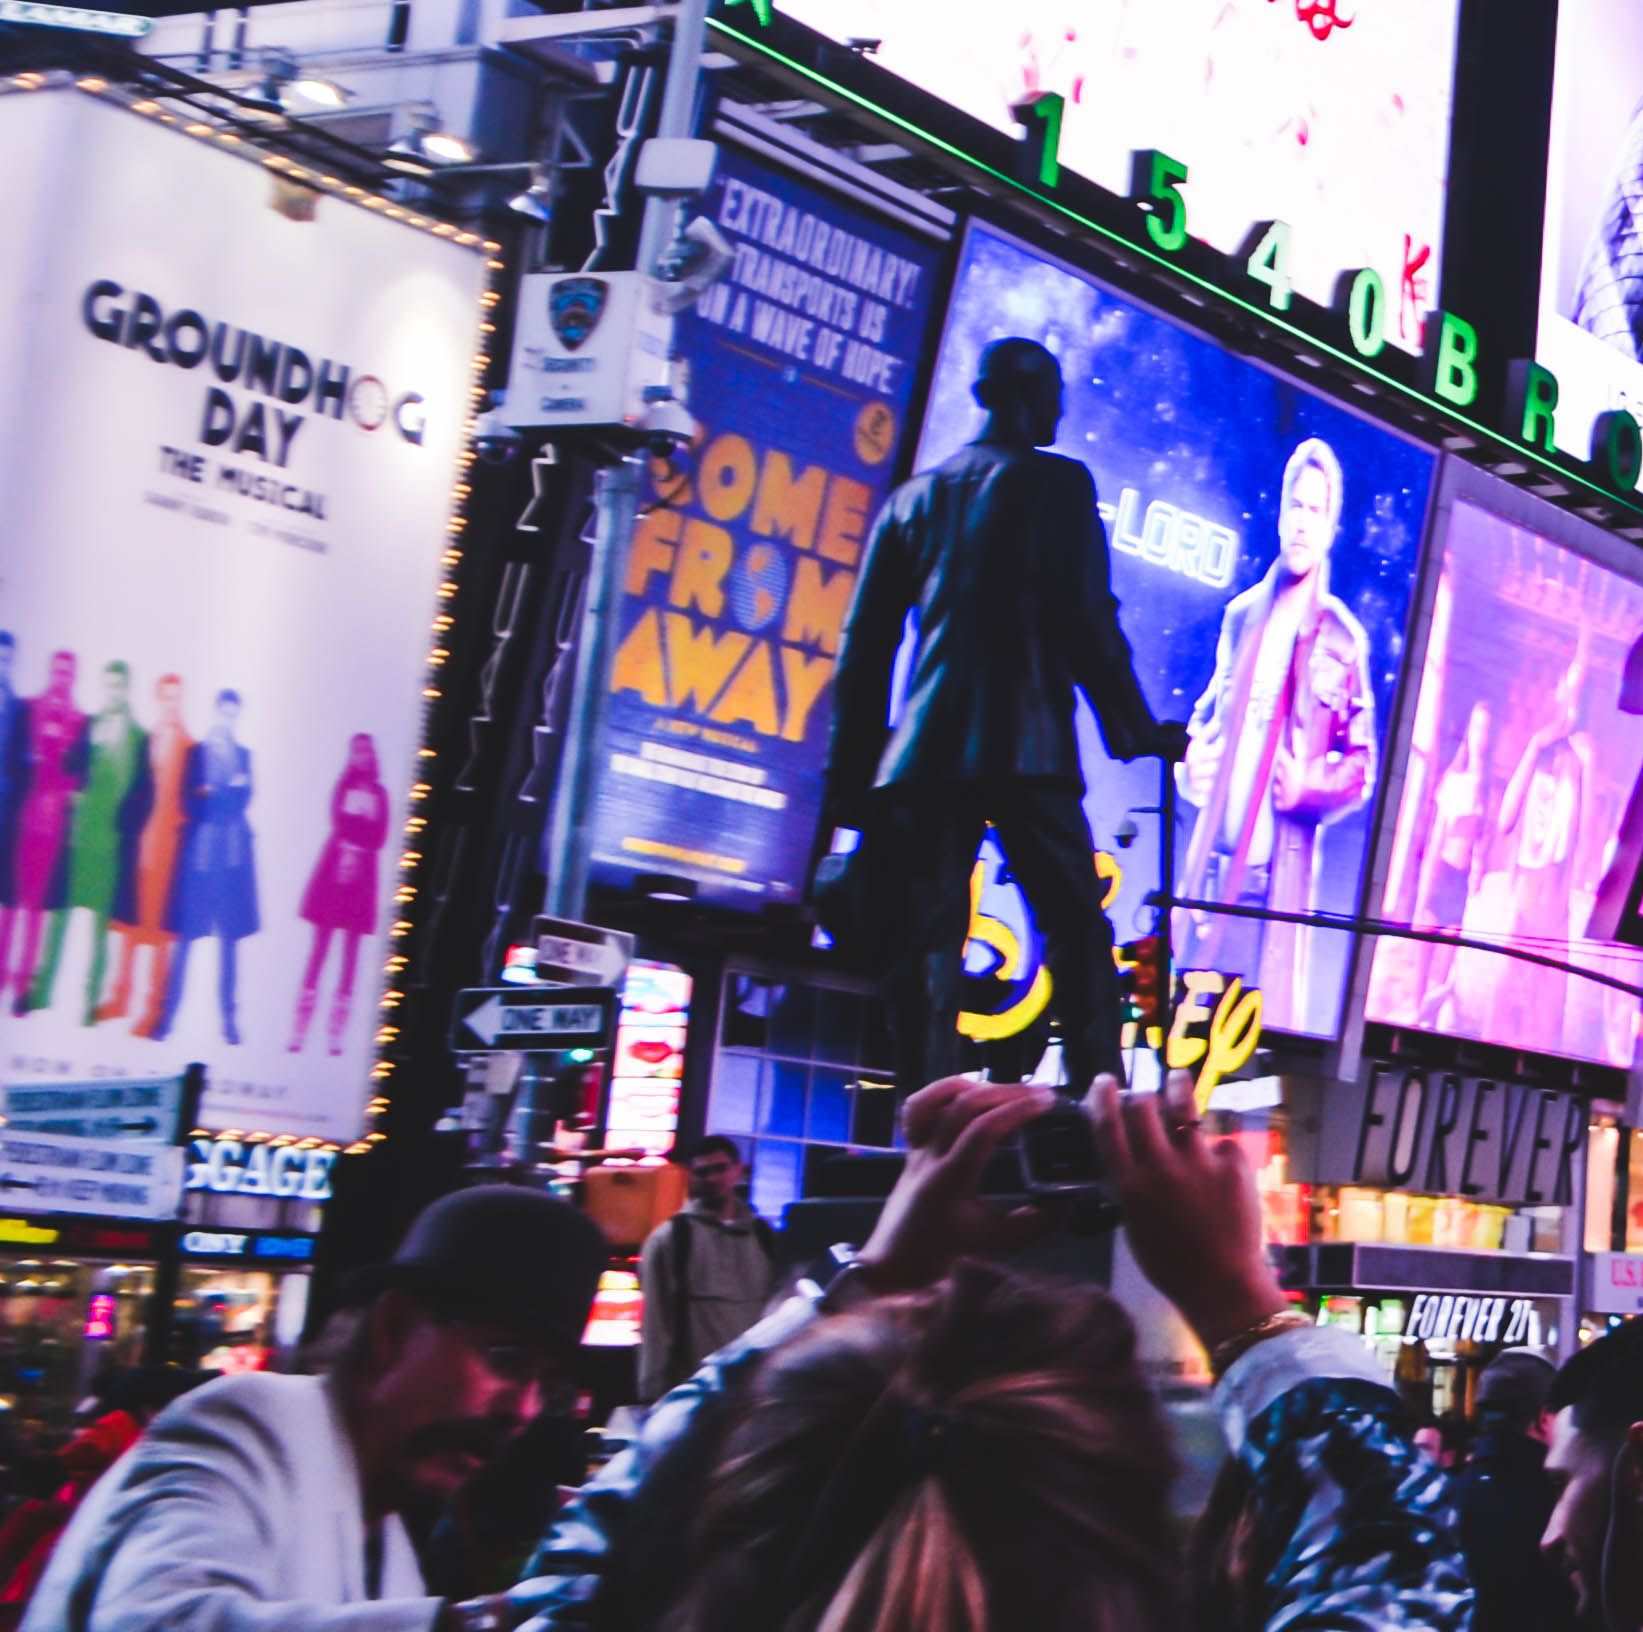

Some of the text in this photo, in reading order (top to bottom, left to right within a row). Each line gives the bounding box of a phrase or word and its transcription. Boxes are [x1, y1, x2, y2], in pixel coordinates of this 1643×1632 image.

[1012, 91, 1387, 358] 1540
[731, 240, 888, 346] TRANSPORTS US
[750, 298, 815, 362] WAVE
[812, 326, 846, 370] OF
[81, 277, 428, 447] GROUNDHOG
[157, 443, 206, 484] THE
[197, 385, 307, 469] DAY
[215, 466, 328, 521] MUSICAL
[608, 602, 834, 743] AWAY
[504, 1005, 599, 1031] ONE WAY
[1351, 1062, 1592, 1206] FOREVER
[1403, 1293, 1506, 1345] FOREVER
